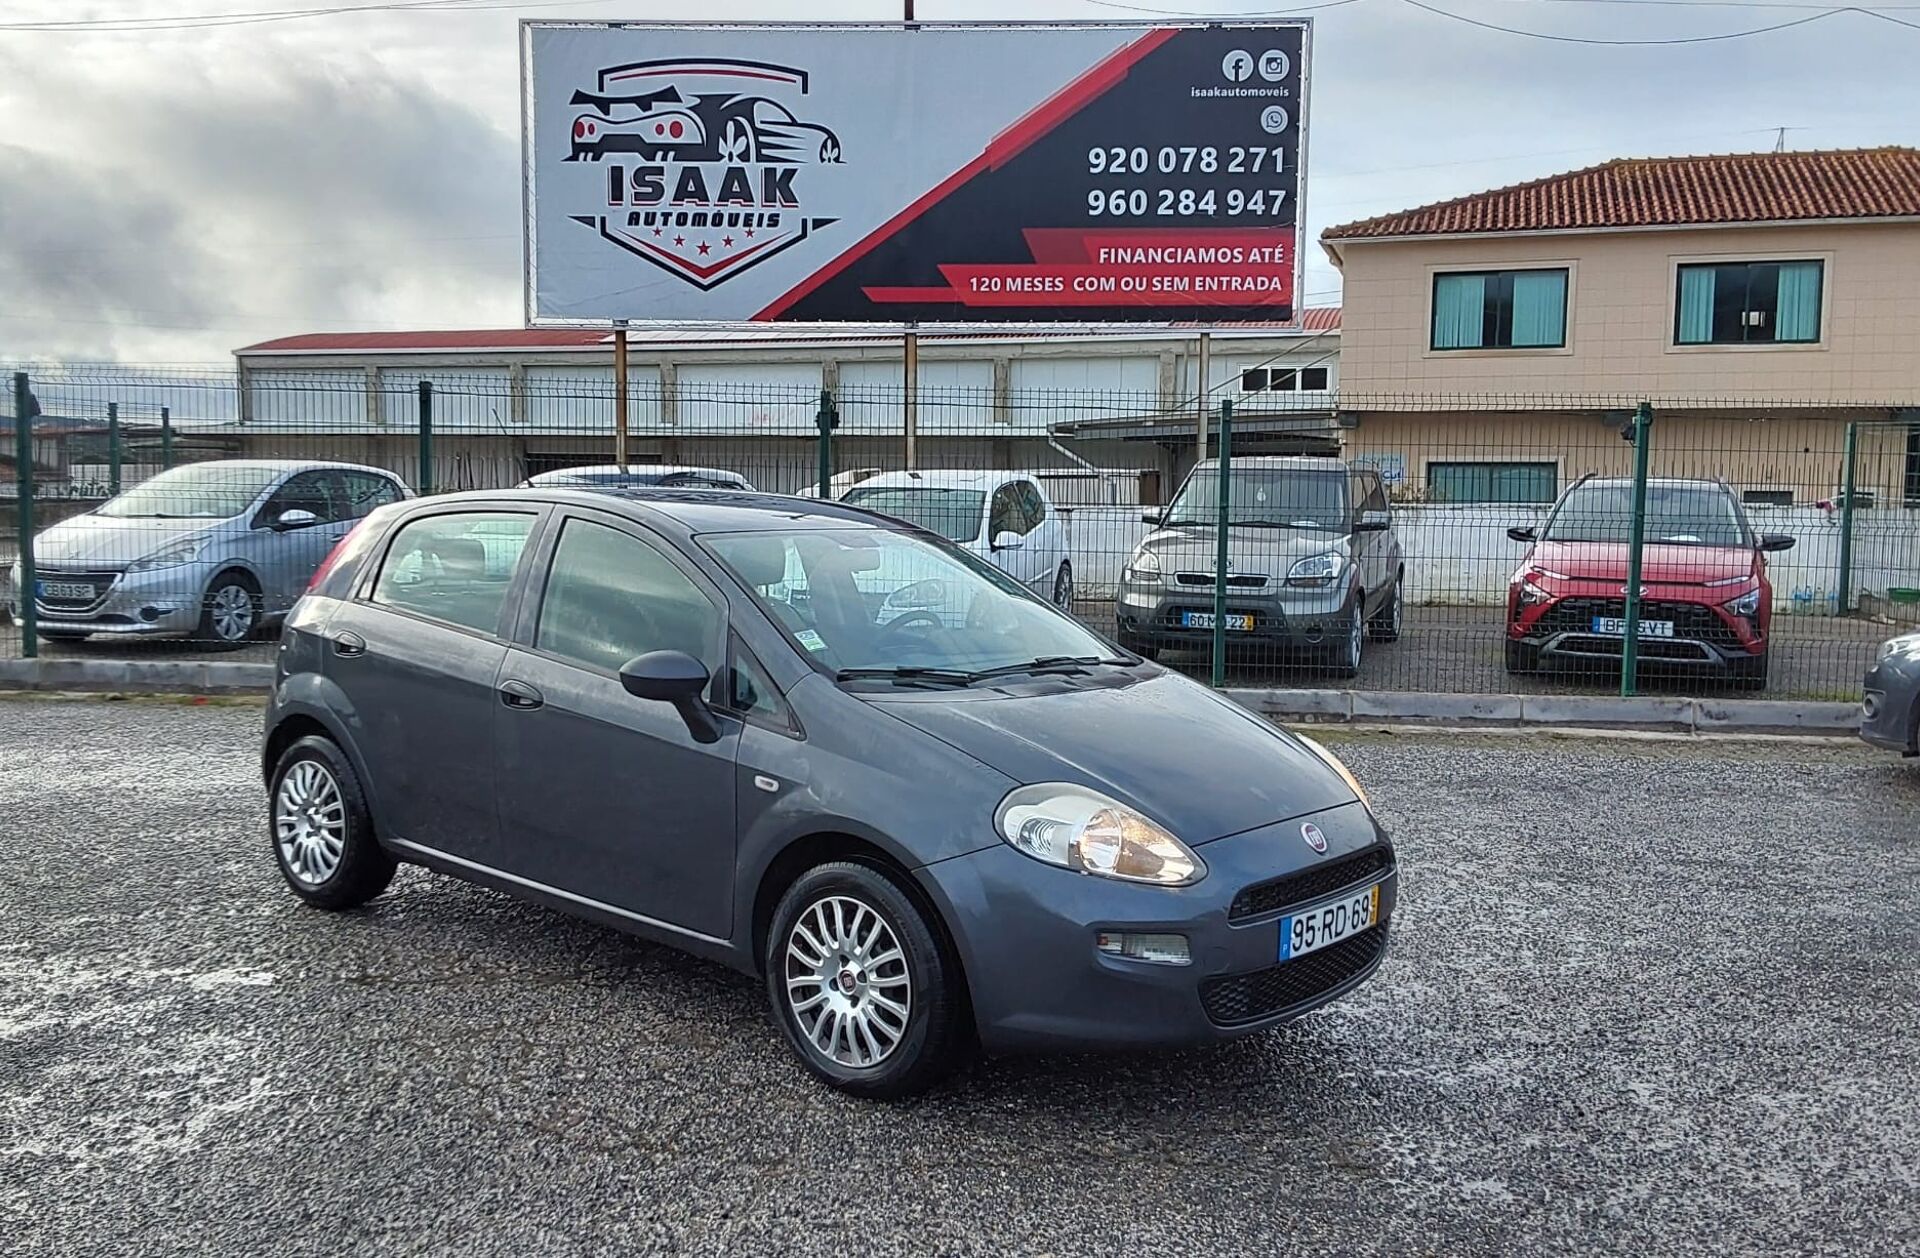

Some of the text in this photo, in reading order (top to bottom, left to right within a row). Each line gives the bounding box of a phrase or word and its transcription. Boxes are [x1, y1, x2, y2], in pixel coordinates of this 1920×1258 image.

[1191, 86, 1289, 97] isaakautomoveis
[1088, 147, 1284, 173] 920 078 271
[607, 165, 800, 208] ISAAK
[1088, 189, 1286, 216] 960 284 947
[1099, 244, 1285, 264] FINANCIAMOS ATÉ
[969, 276, 1283, 292] 120 MESES COM OU SEM ENTRADA
